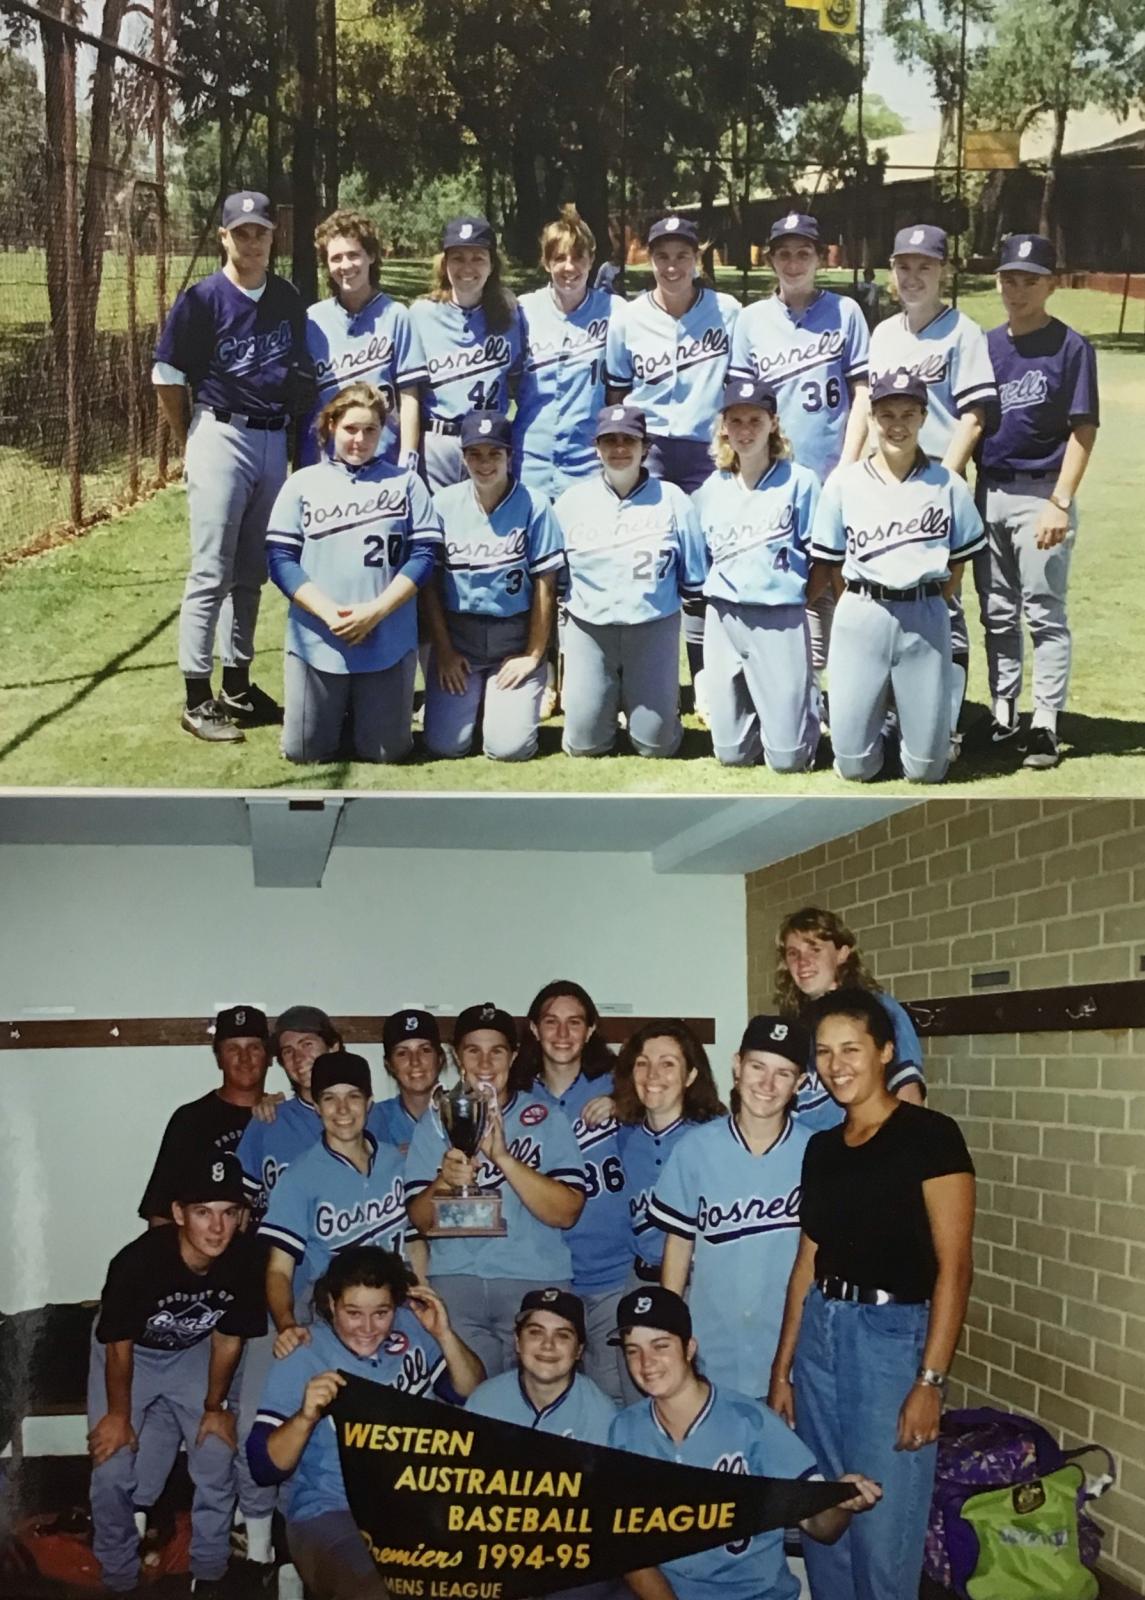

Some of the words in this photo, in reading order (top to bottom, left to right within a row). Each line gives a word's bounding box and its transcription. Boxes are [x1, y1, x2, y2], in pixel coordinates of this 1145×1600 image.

[316, 335, 395, 379] osnells
[428, 335, 510, 374] osnells
[633, 327, 729, 379] Gosnells
[467, 380, 500, 410] 42
[801, 378, 840, 412] 36
[446, 529, 528, 557] osnell
[846, 506, 950, 555] Gosnells
[632, 547, 674, 580] 27
[772, 546, 791, 574] 4
[505, 569, 524, 595] 3
[316, 1177, 407, 1237] Gosnel
[697, 1185, 802, 1232] Gosnel
[344, 1421, 475, 1458] WESTERN
[393, 1464, 582, 1499] AUSTRALIAN
[448, 1504, 594, 1534] BASEBALL
[612, 1502, 736, 1534] LEAGUE
[477, 1543, 592, 1571] 1994-95
[430, 1580, 504, 1600] LEAGUE
